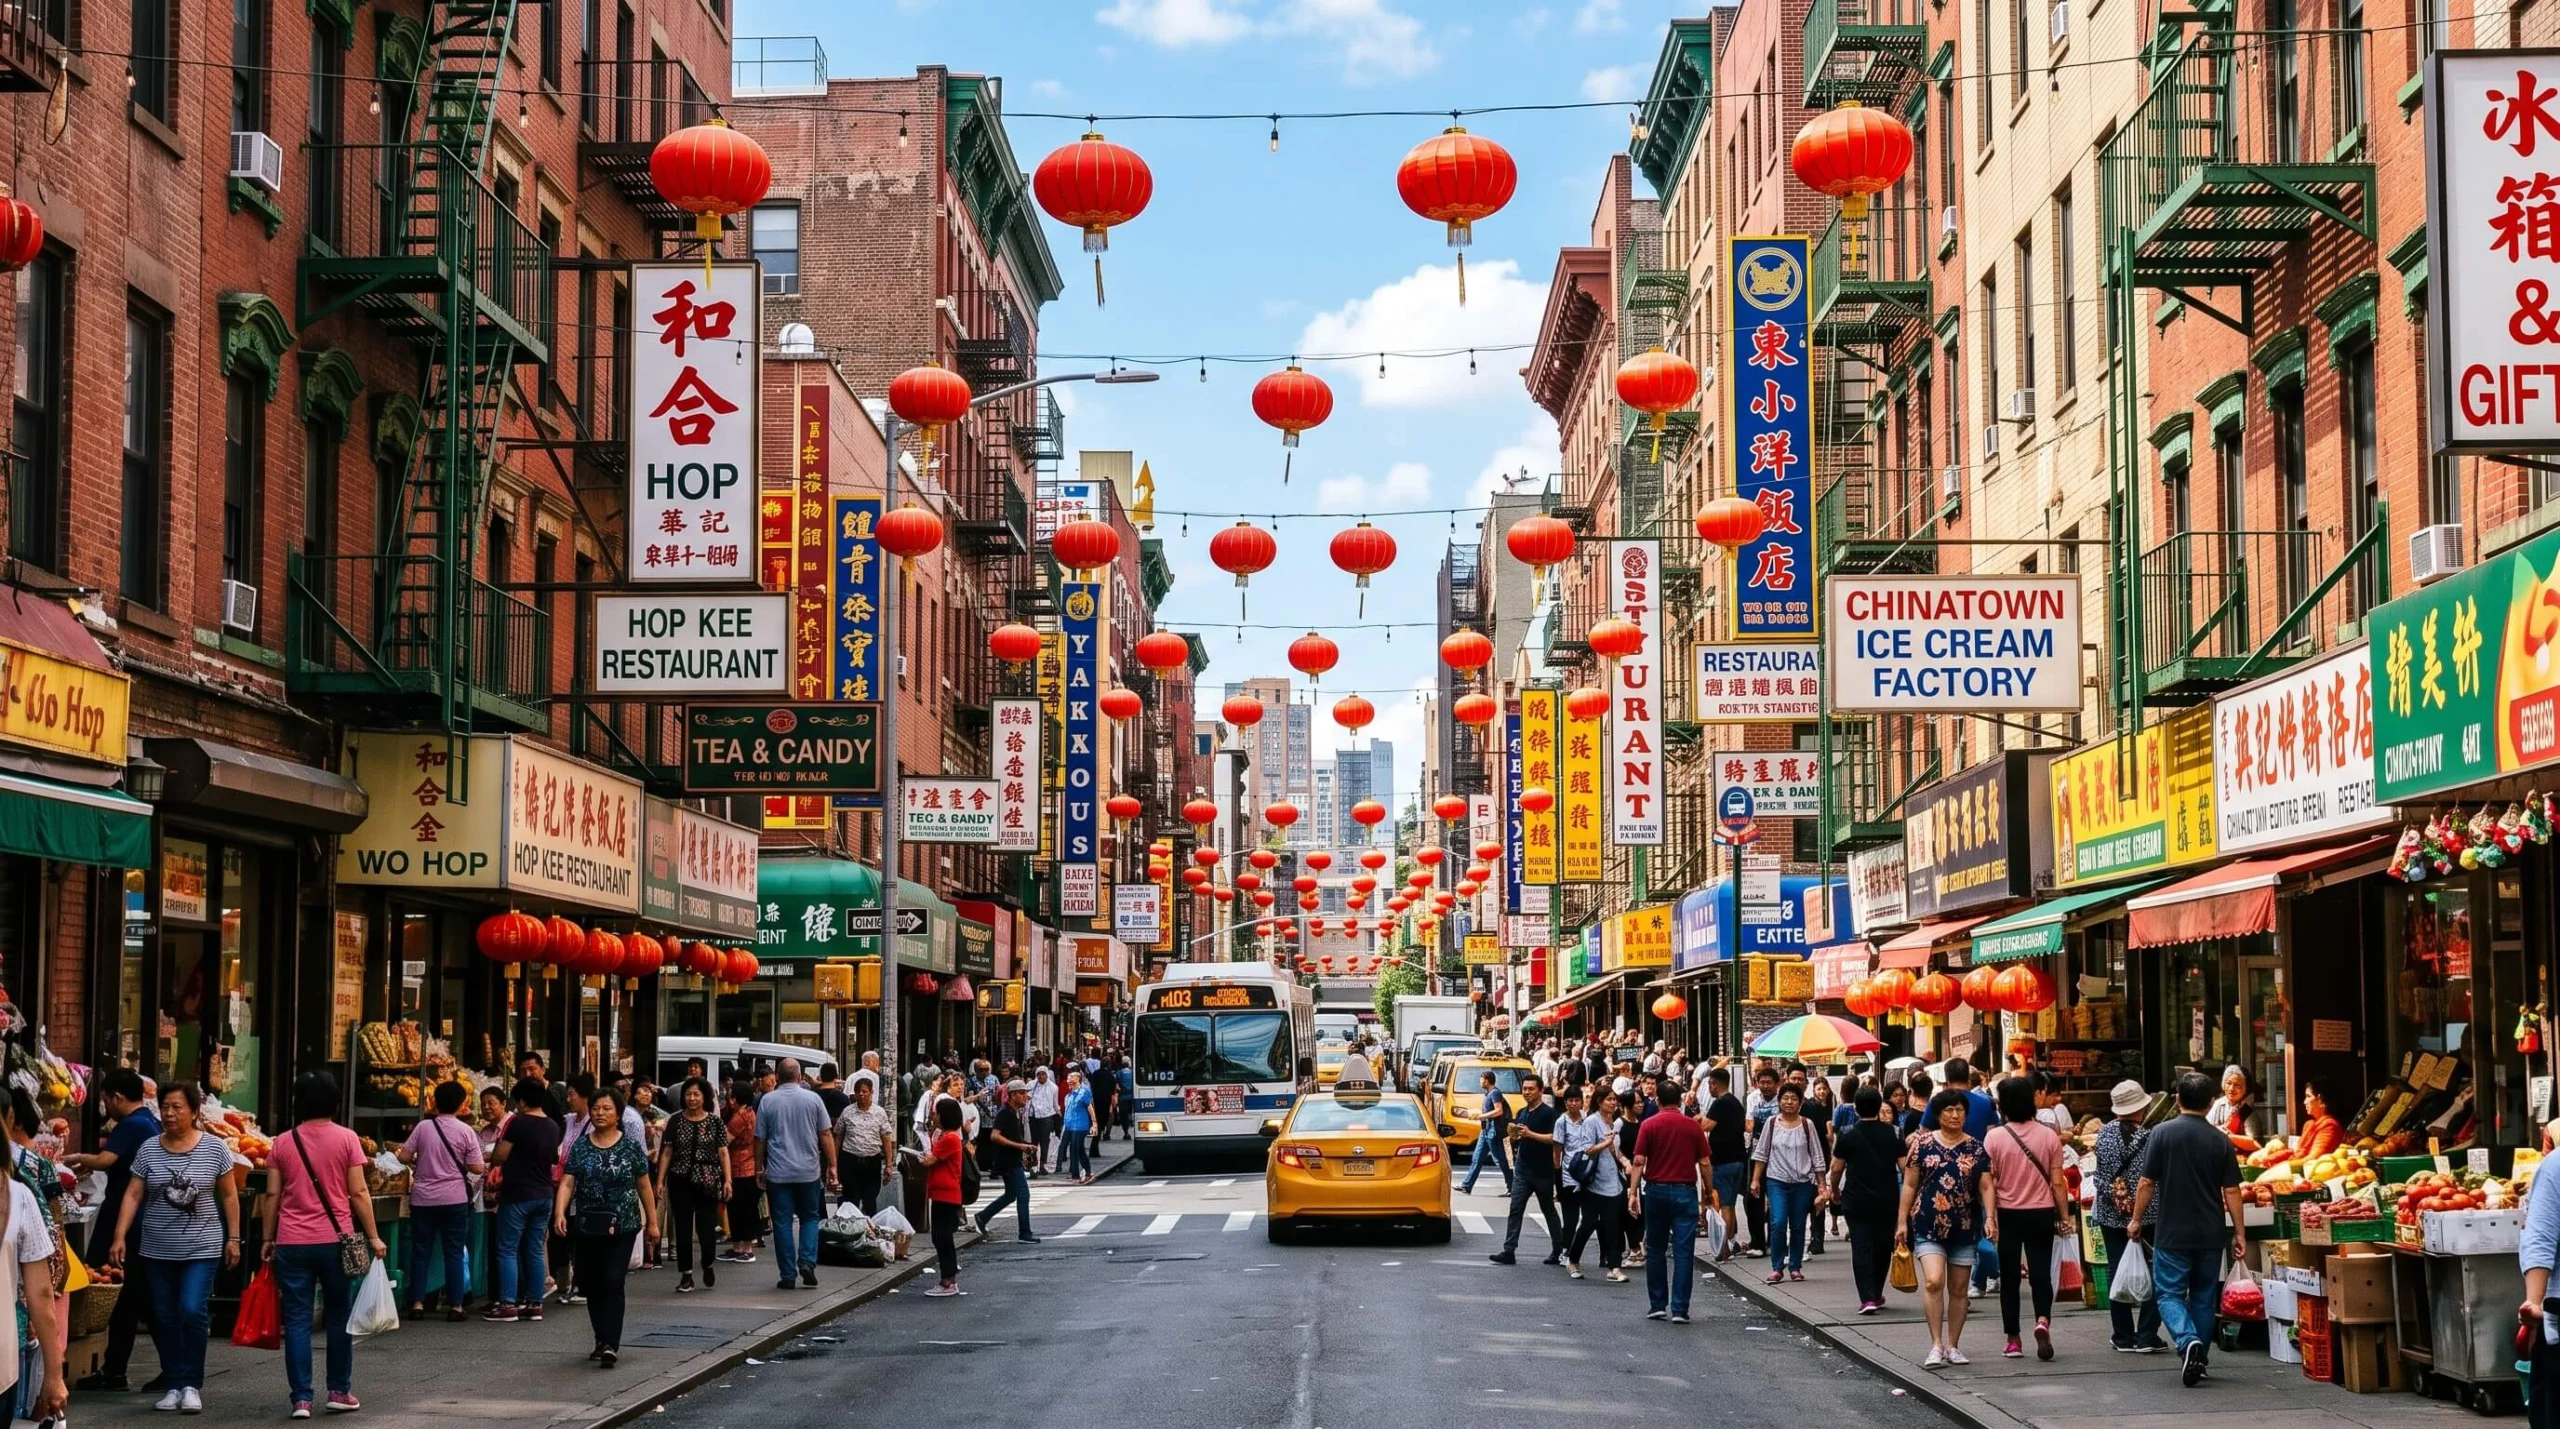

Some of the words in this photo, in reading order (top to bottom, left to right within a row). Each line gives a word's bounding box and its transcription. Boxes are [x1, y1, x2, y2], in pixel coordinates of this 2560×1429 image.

[2483, 70, 2560, 263] 冰箱
[2509, 279, 2560, 346] &
[649, 280, 739, 446] 和合
[647, 463, 739, 500] HOP
[1846, 590, 2064, 621] CHINATOWN
[628, 608, 686, 638] HOP
[699, 608, 753, 638] KEE
[1857, 628, 1911, 659] ICE
[1924, 628, 2054, 659] CREAM
[602, 649, 779, 680] RESTAURANT
[1873, 666, 2037, 698] FACTORY
[63, 685, 105, 753] Hop
[692, 738, 745, 764] TEA
[752, 738, 770, 764] &
[777, 738, 872, 764] CANDY
[411, 741, 448, 843] 和合金
[938, 814, 947, 823] &
[357, 850, 409, 875] WO
[423, 851, 488, 876] HOP
[514, 841, 539, 876] HOP
[542, 848, 564, 882] KEE
[567, 854, 632, 897] RESTAURANT
